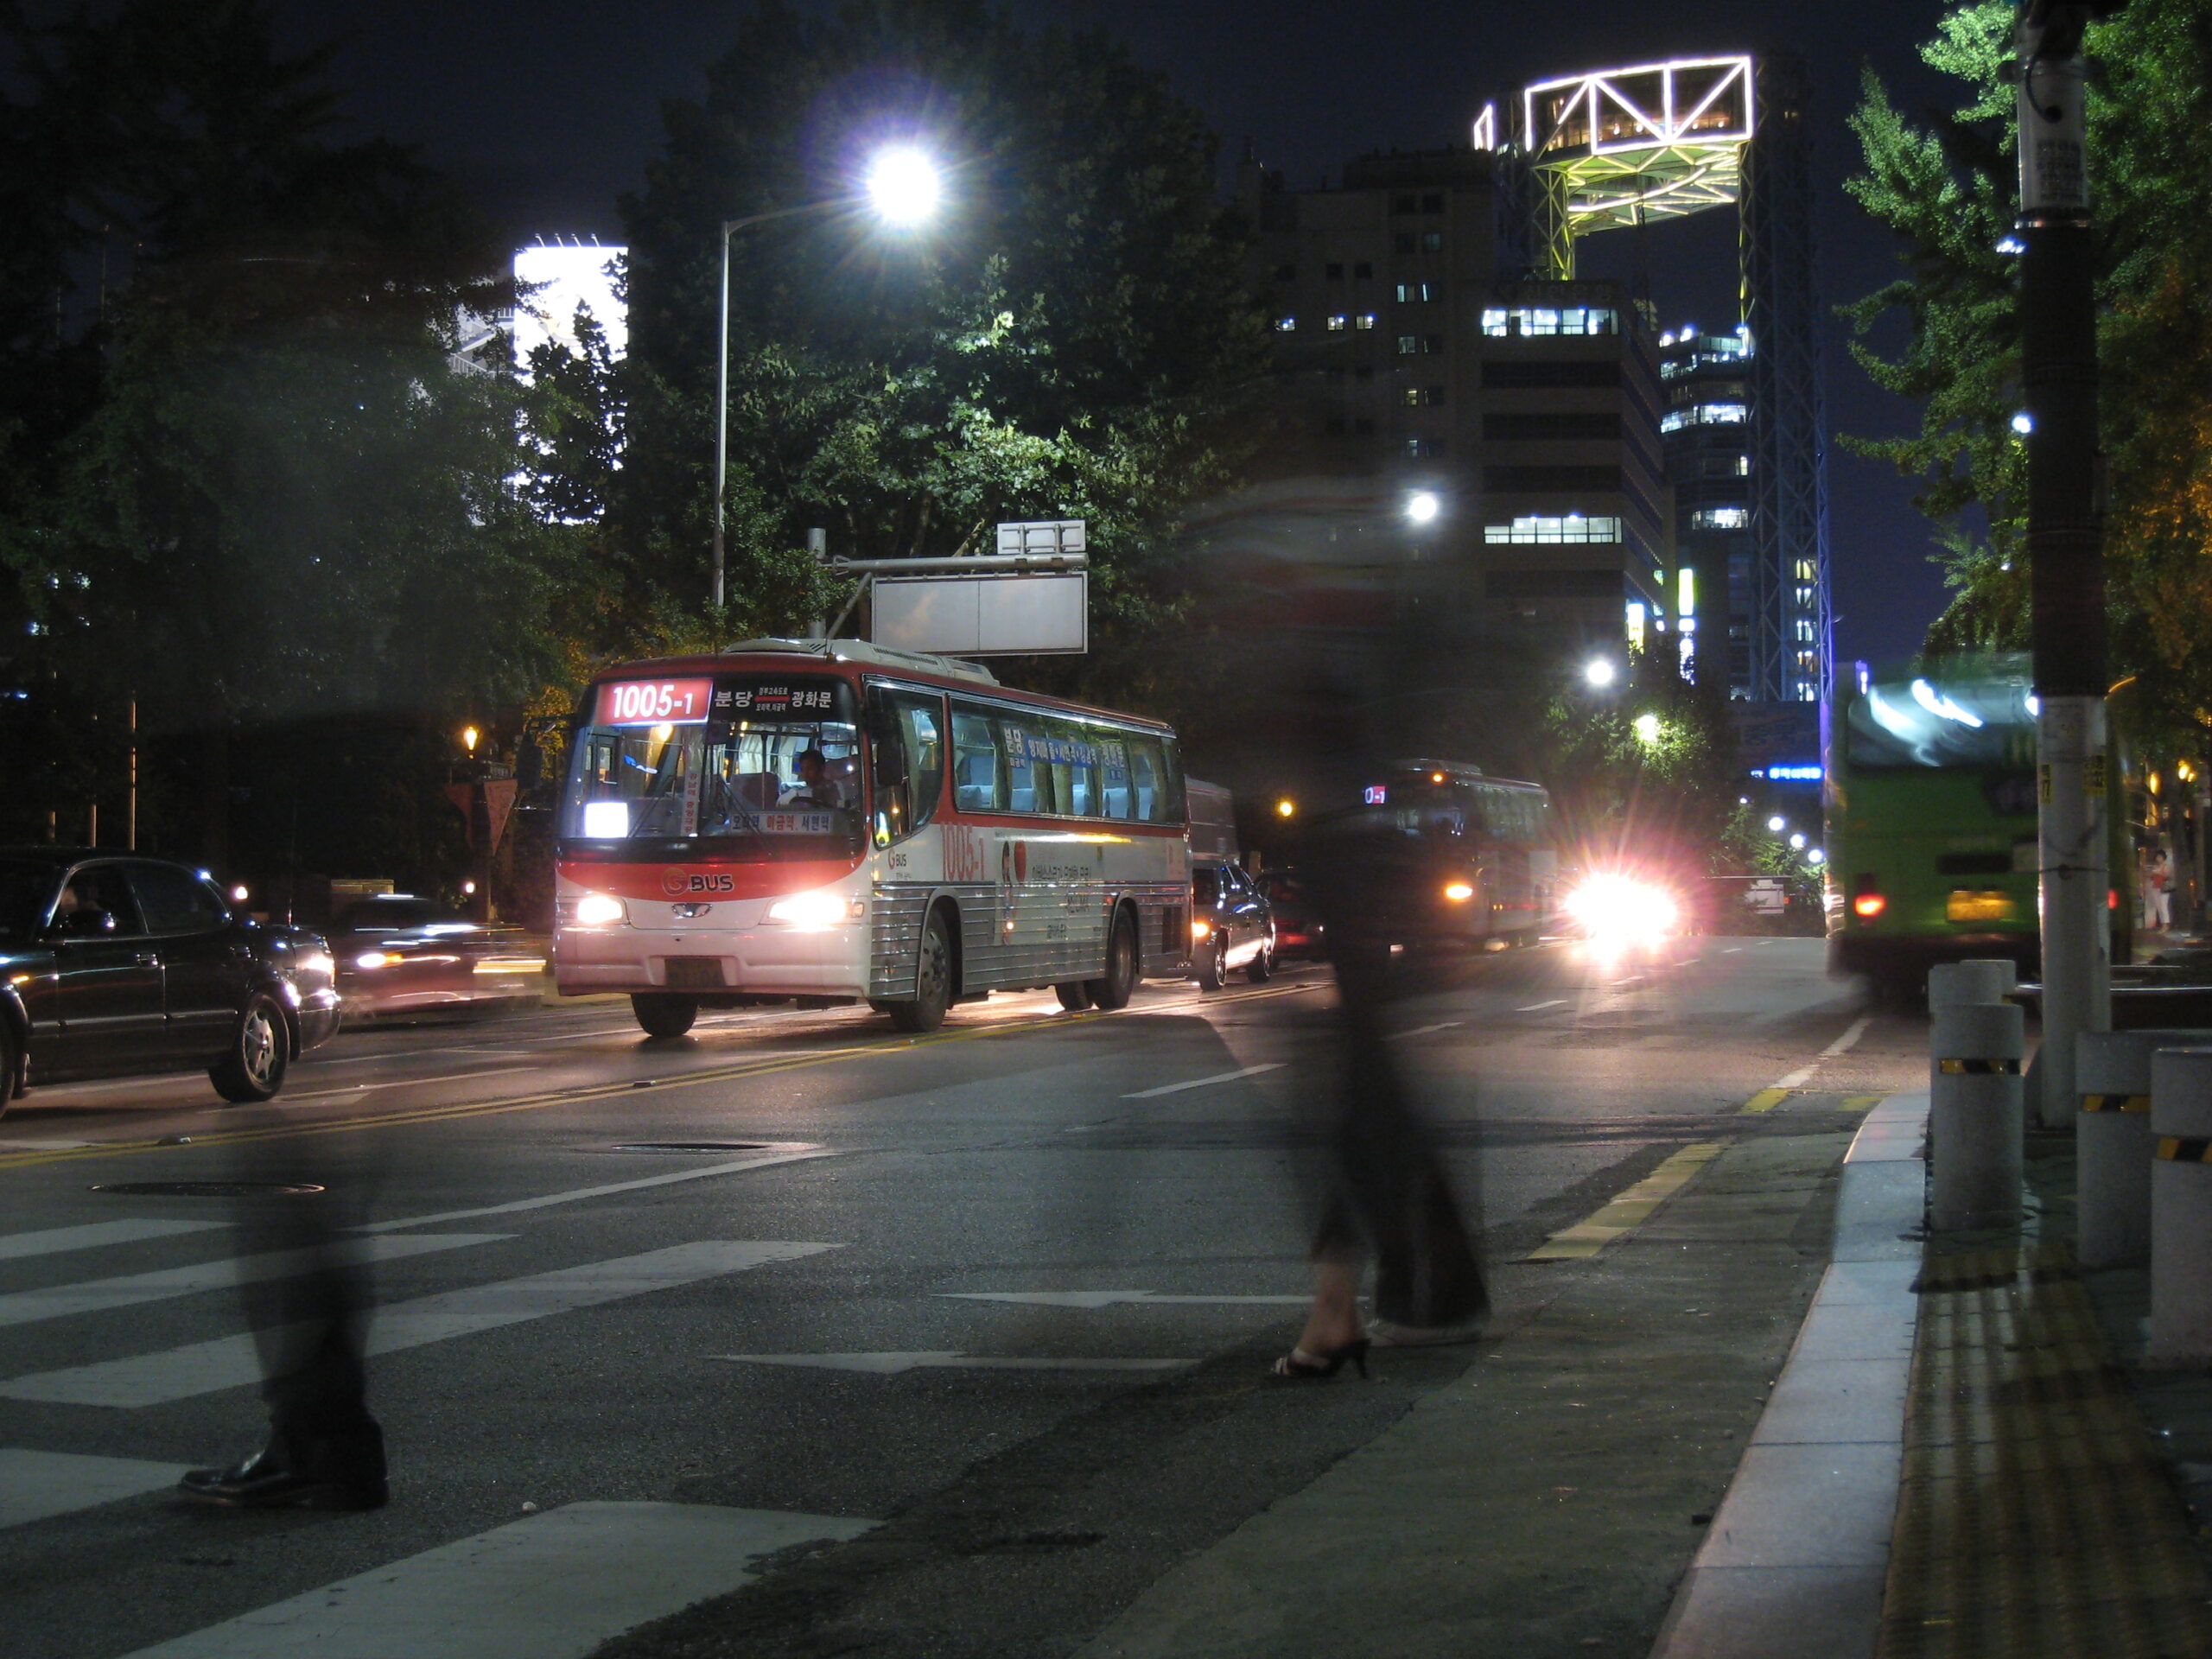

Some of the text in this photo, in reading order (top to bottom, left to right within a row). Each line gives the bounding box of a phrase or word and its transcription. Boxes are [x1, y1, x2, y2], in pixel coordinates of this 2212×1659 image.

[612, 683, 693, 718] 1005-1
[715, 690, 753, 709] 분당
[791, 690, 832, 709] 광화문
[801, 815, 830, 832] 서현역
[940, 821, 985, 881] 1005-1
[690, 874, 734, 892] BUS
